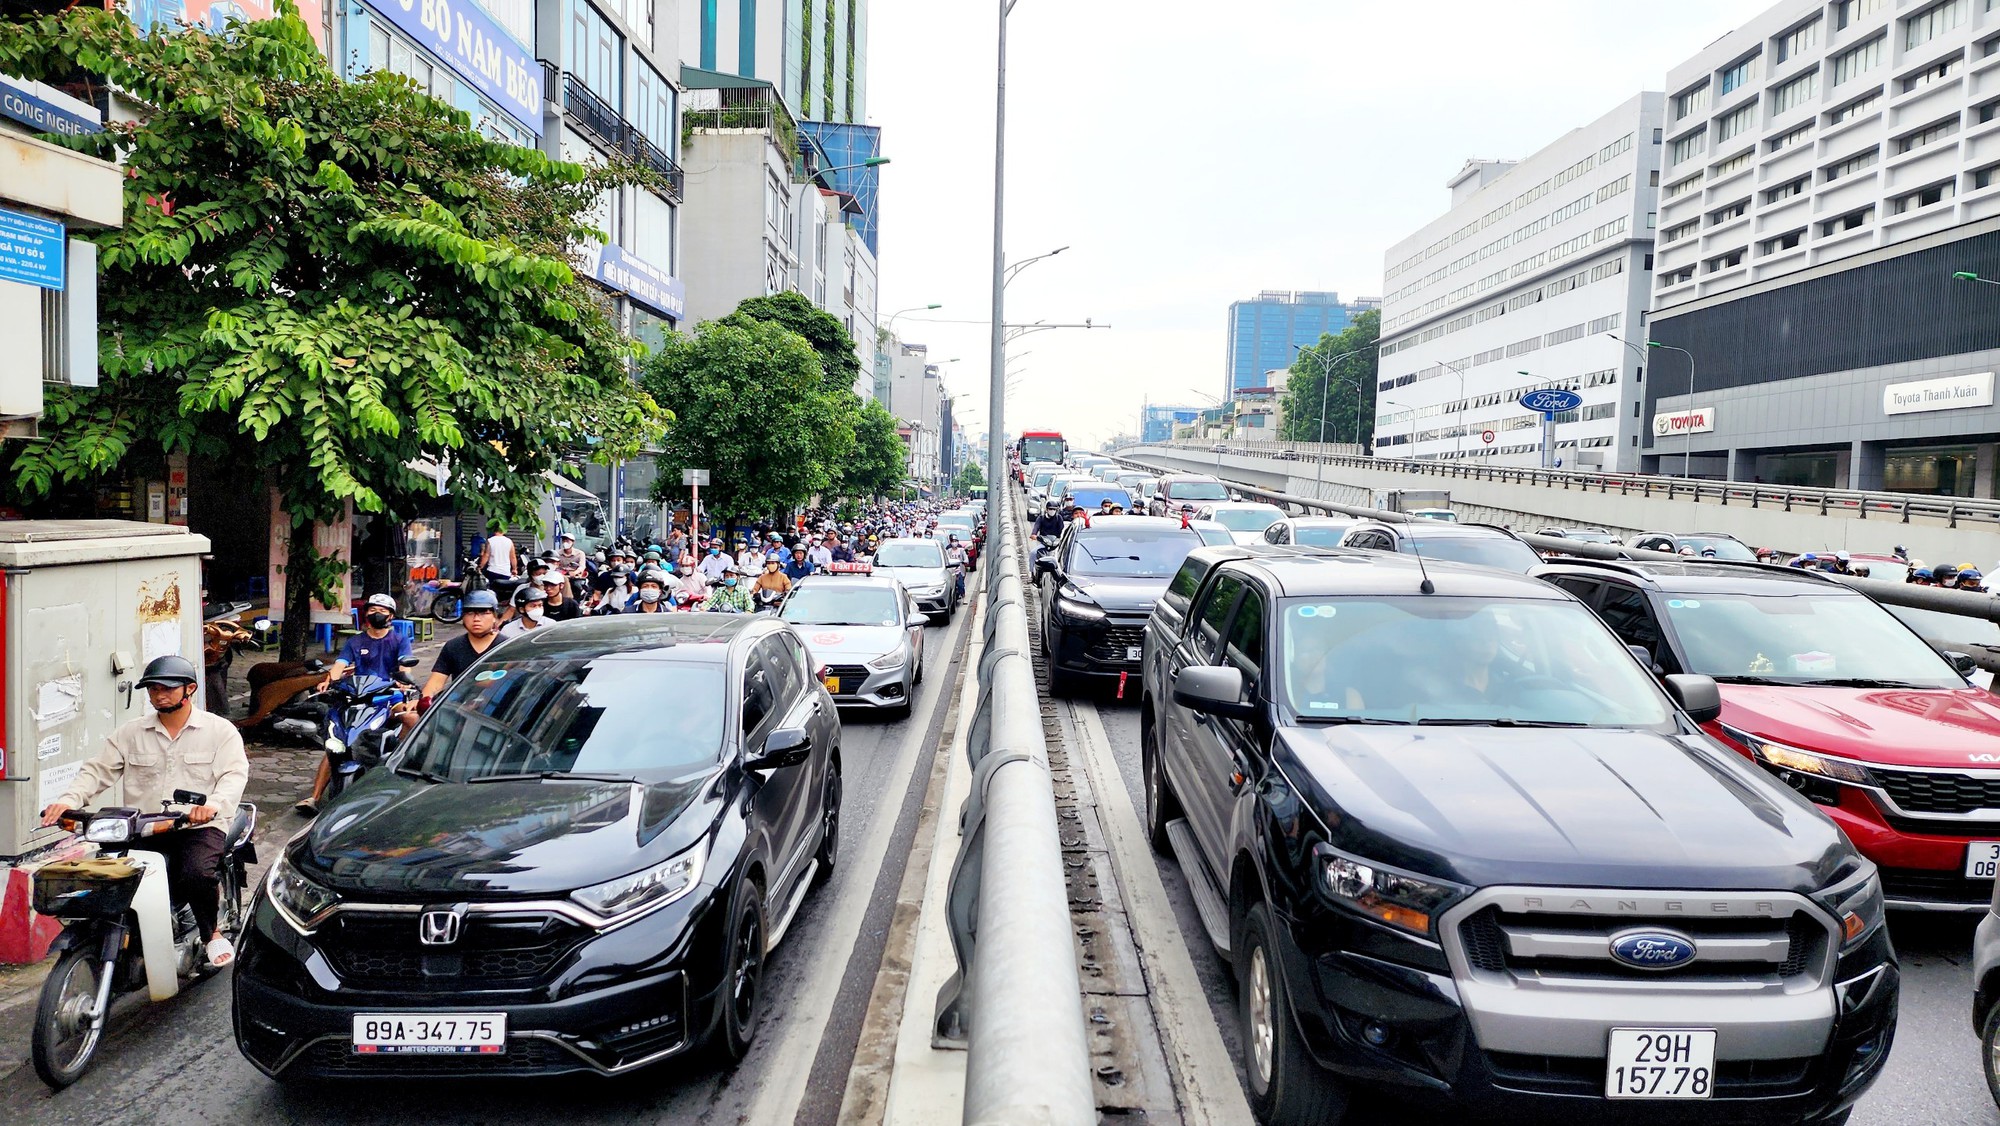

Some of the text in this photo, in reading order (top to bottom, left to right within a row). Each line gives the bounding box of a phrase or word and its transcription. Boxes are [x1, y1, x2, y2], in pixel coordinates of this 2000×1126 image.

[456, 11, 502, 88] NAM
[505, 57, 539, 116] BÉO
[4, 94, 44, 124] CÔNG
[1532, 393, 1570, 408] Ford
[1893, 384, 1978, 406] Toyota Thanh Xuân
[1669, 414, 1705, 430] TOYOTA
[833, 562, 869, 571] Taxi 123
[1523, 897, 1773, 912] RANGER
[1632, 940, 1678, 961] Ford
[366, 1021, 492, 1040] 89A-347.75
[1635, 1034, 1691, 1062] 29H
[1615, 1066, 1709, 1095] 157.78
